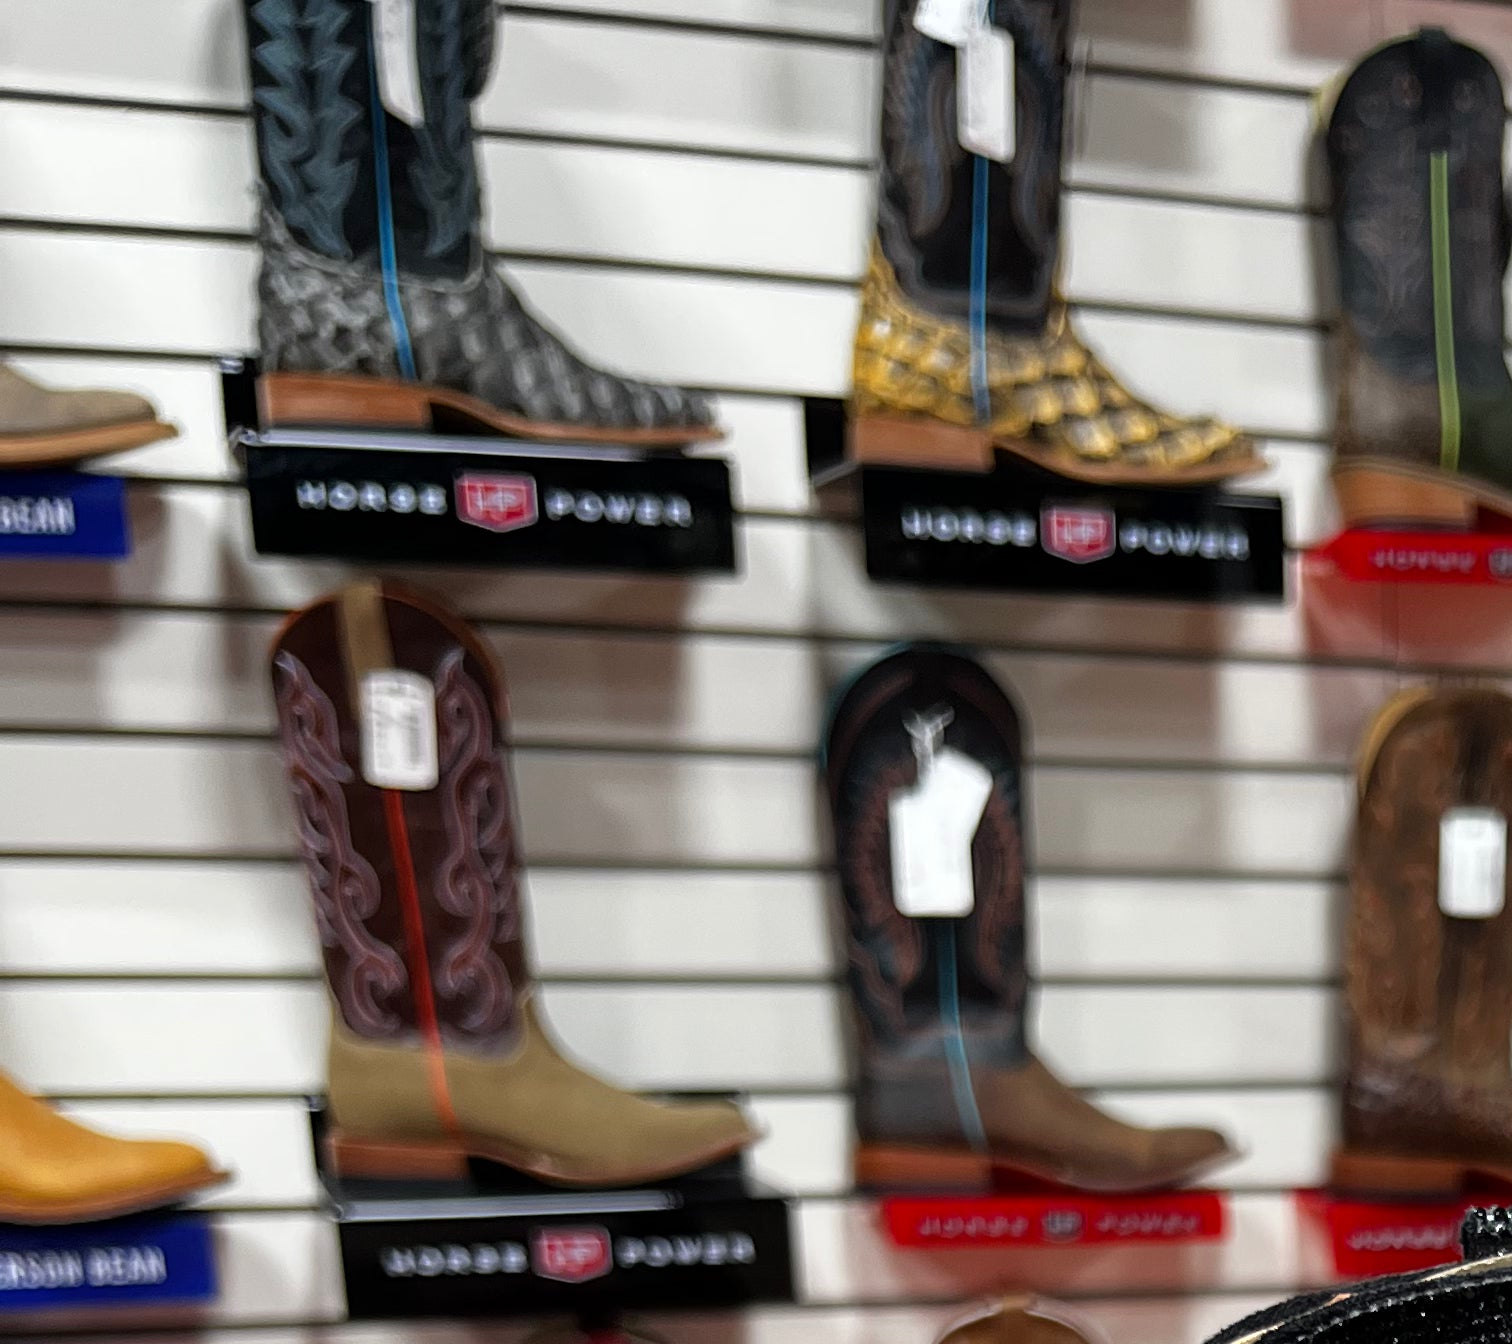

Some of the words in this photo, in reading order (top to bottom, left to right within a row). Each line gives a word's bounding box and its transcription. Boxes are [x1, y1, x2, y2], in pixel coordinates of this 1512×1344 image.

[297, 478, 447, 516] HORSE
[544, 489, 693, 529] POWER
[1119, 521, 1250, 561] POWER
